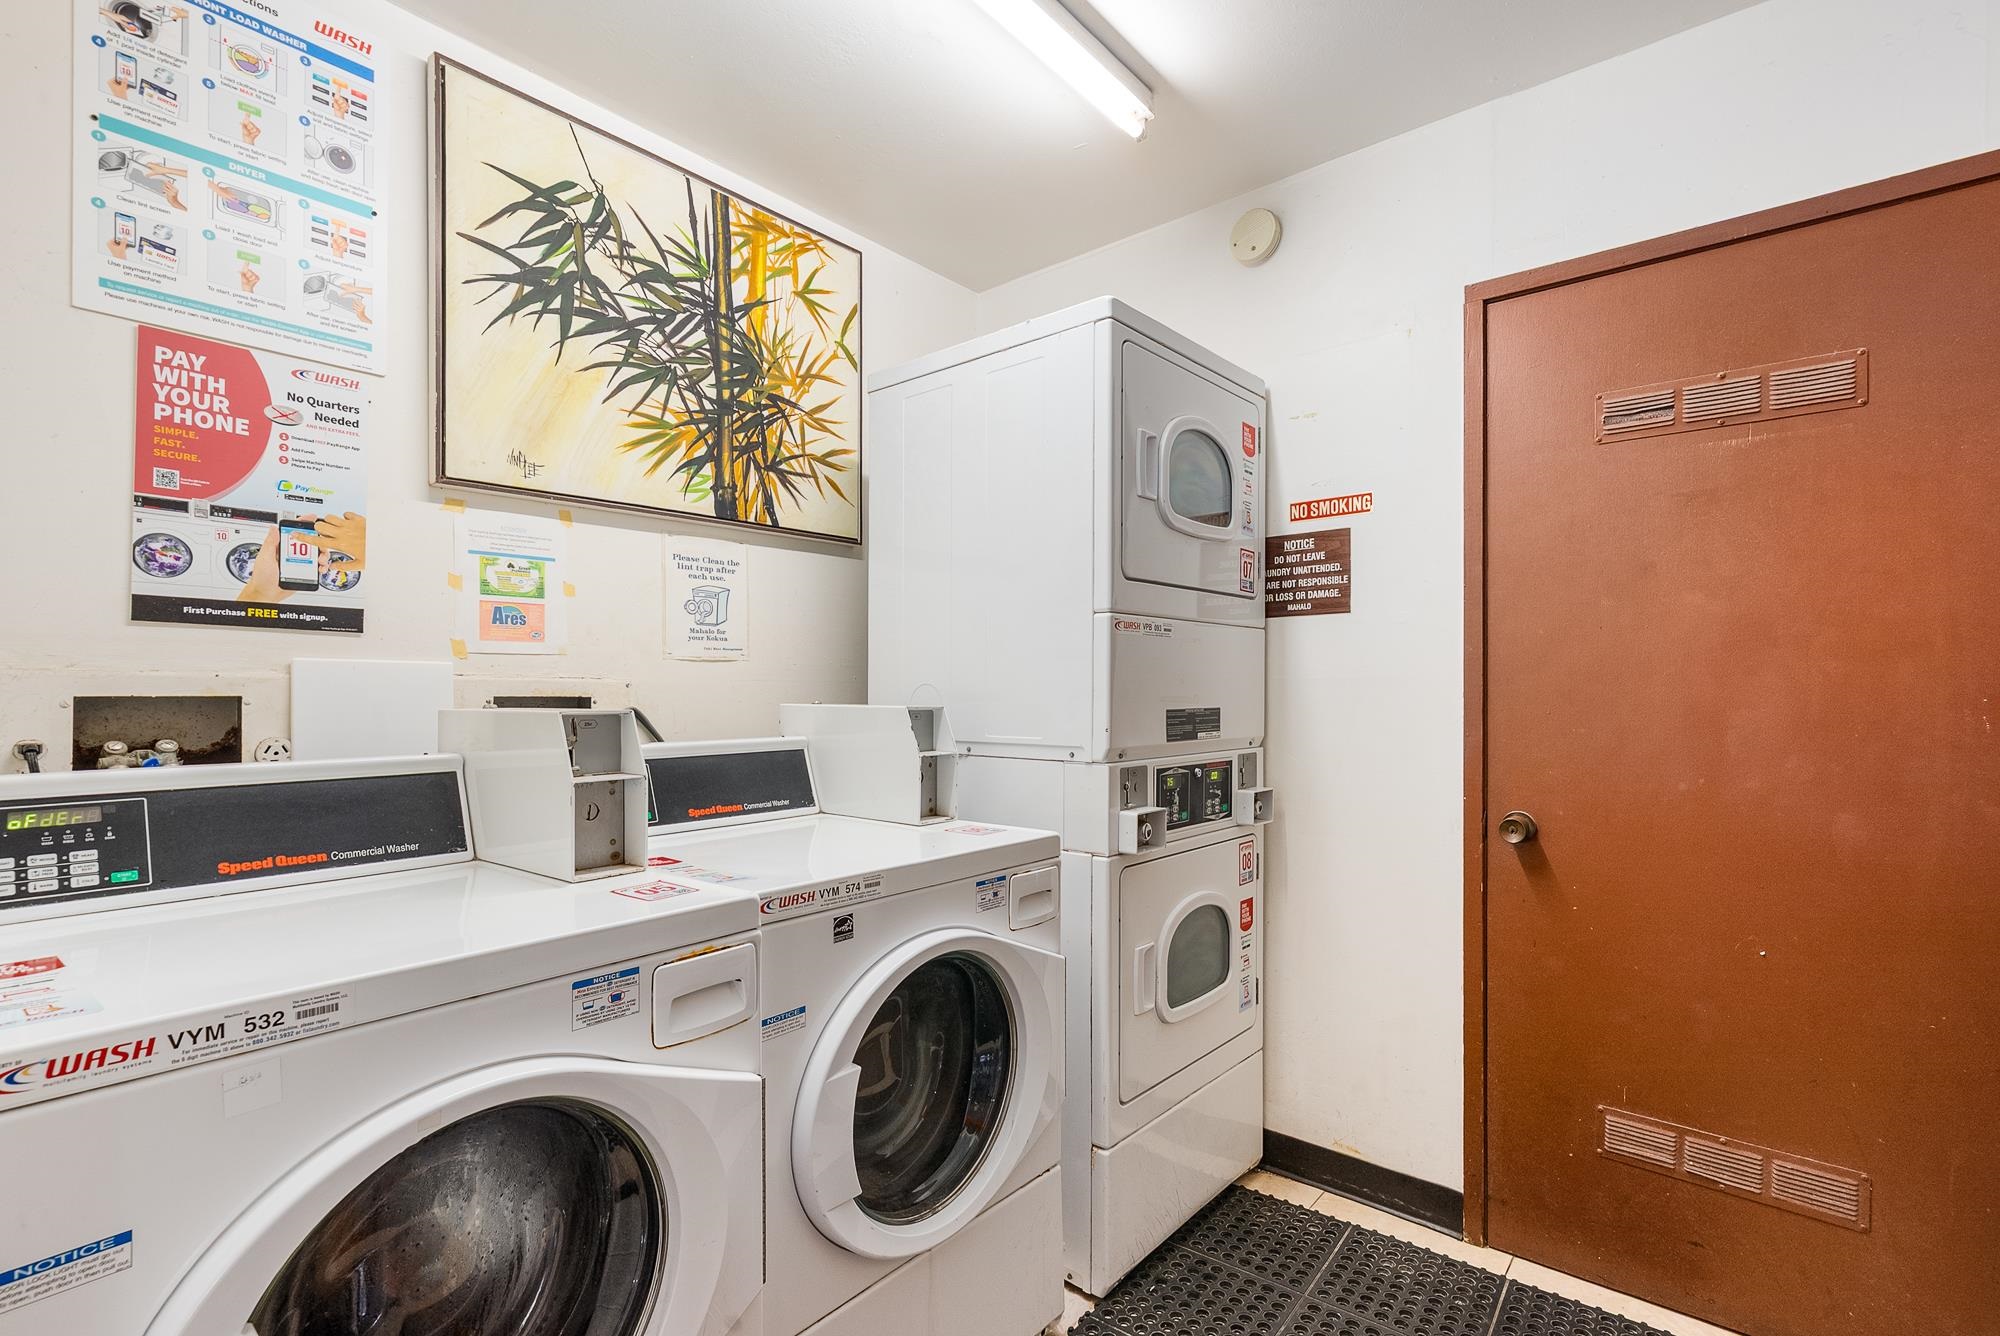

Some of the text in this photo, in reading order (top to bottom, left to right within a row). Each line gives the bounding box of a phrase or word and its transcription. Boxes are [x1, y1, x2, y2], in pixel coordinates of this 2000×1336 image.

[194, 0, 308, 52] RONT LOAD WASHER
[314, 20, 372, 55] WASH
[229, 162, 266, 181] DRYER
[155, 346, 207, 371] PAY
[153, 364, 225, 395] WITH
[315, 372, 360, 390] WASH
[152, 383, 230, 414] YOUR
[287, 392, 359, 414] No Quarters
[154, 403, 249, 436] PHONE
[314, 412, 359, 428] Needed
[154, 425, 199, 440] SIMPLE.
[154, 437, 185, 448] FAST.
[153, 449, 201, 462] SECURE.
[295, 484, 336, 495] PayRange
[1291, 495, 1371, 520] NO SMOKING
[290, 542, 308, 556] 10
[1284, 538, 1314, 550] NOTICE
[672, 554, 699, 563] Please
[703, 556, 724, 565] Clean
[1275, 552, 1325, 564] DO NOT LEAVE
[696, 564, 714, 574] trap
[716, 566, 736, 574] after
[1243, 561, 1252, 579] 07
[1266, 563, 1342, 577] UNDRY UNATTENDED.
[1266, 575, 1348, 589] ARE NOT RESPONSIBLE
[1265, 589, 1341, 602] OR LOSS OR DAMAGE.
[183, 606, 205, 615] First
[206, 607, 246, 617] Purchase
[247, 607, 278, 618] FREE
[299, 612, 328, 622] signup.
[492, 606, 526, 625] Ares
[1124, 621, 1140, 630] WASH
[586, 802, 600, 821] D
[688, 805, 716, 818] Speed
[716, 804, 743, 814] Queen
[744, 801, 772, 810] Commercial
[217, 842, 420, 875] Speed Queen Commercial Washer
[1242, 852, 1252, 871] 08
[634, 886, 677, 896] 05
[779, 890, 816, 908] WASH
[819, 886, 840, 899] VYM
[845, 882, 860, 893] 574
[593, 973, 620, 983] NOTICE
[766, 1008, 800, 1024] NOTICE
[46, 1011, 285, 1079] WASH VYM 532
[13, 1237, 116, 1280] NOTICE
